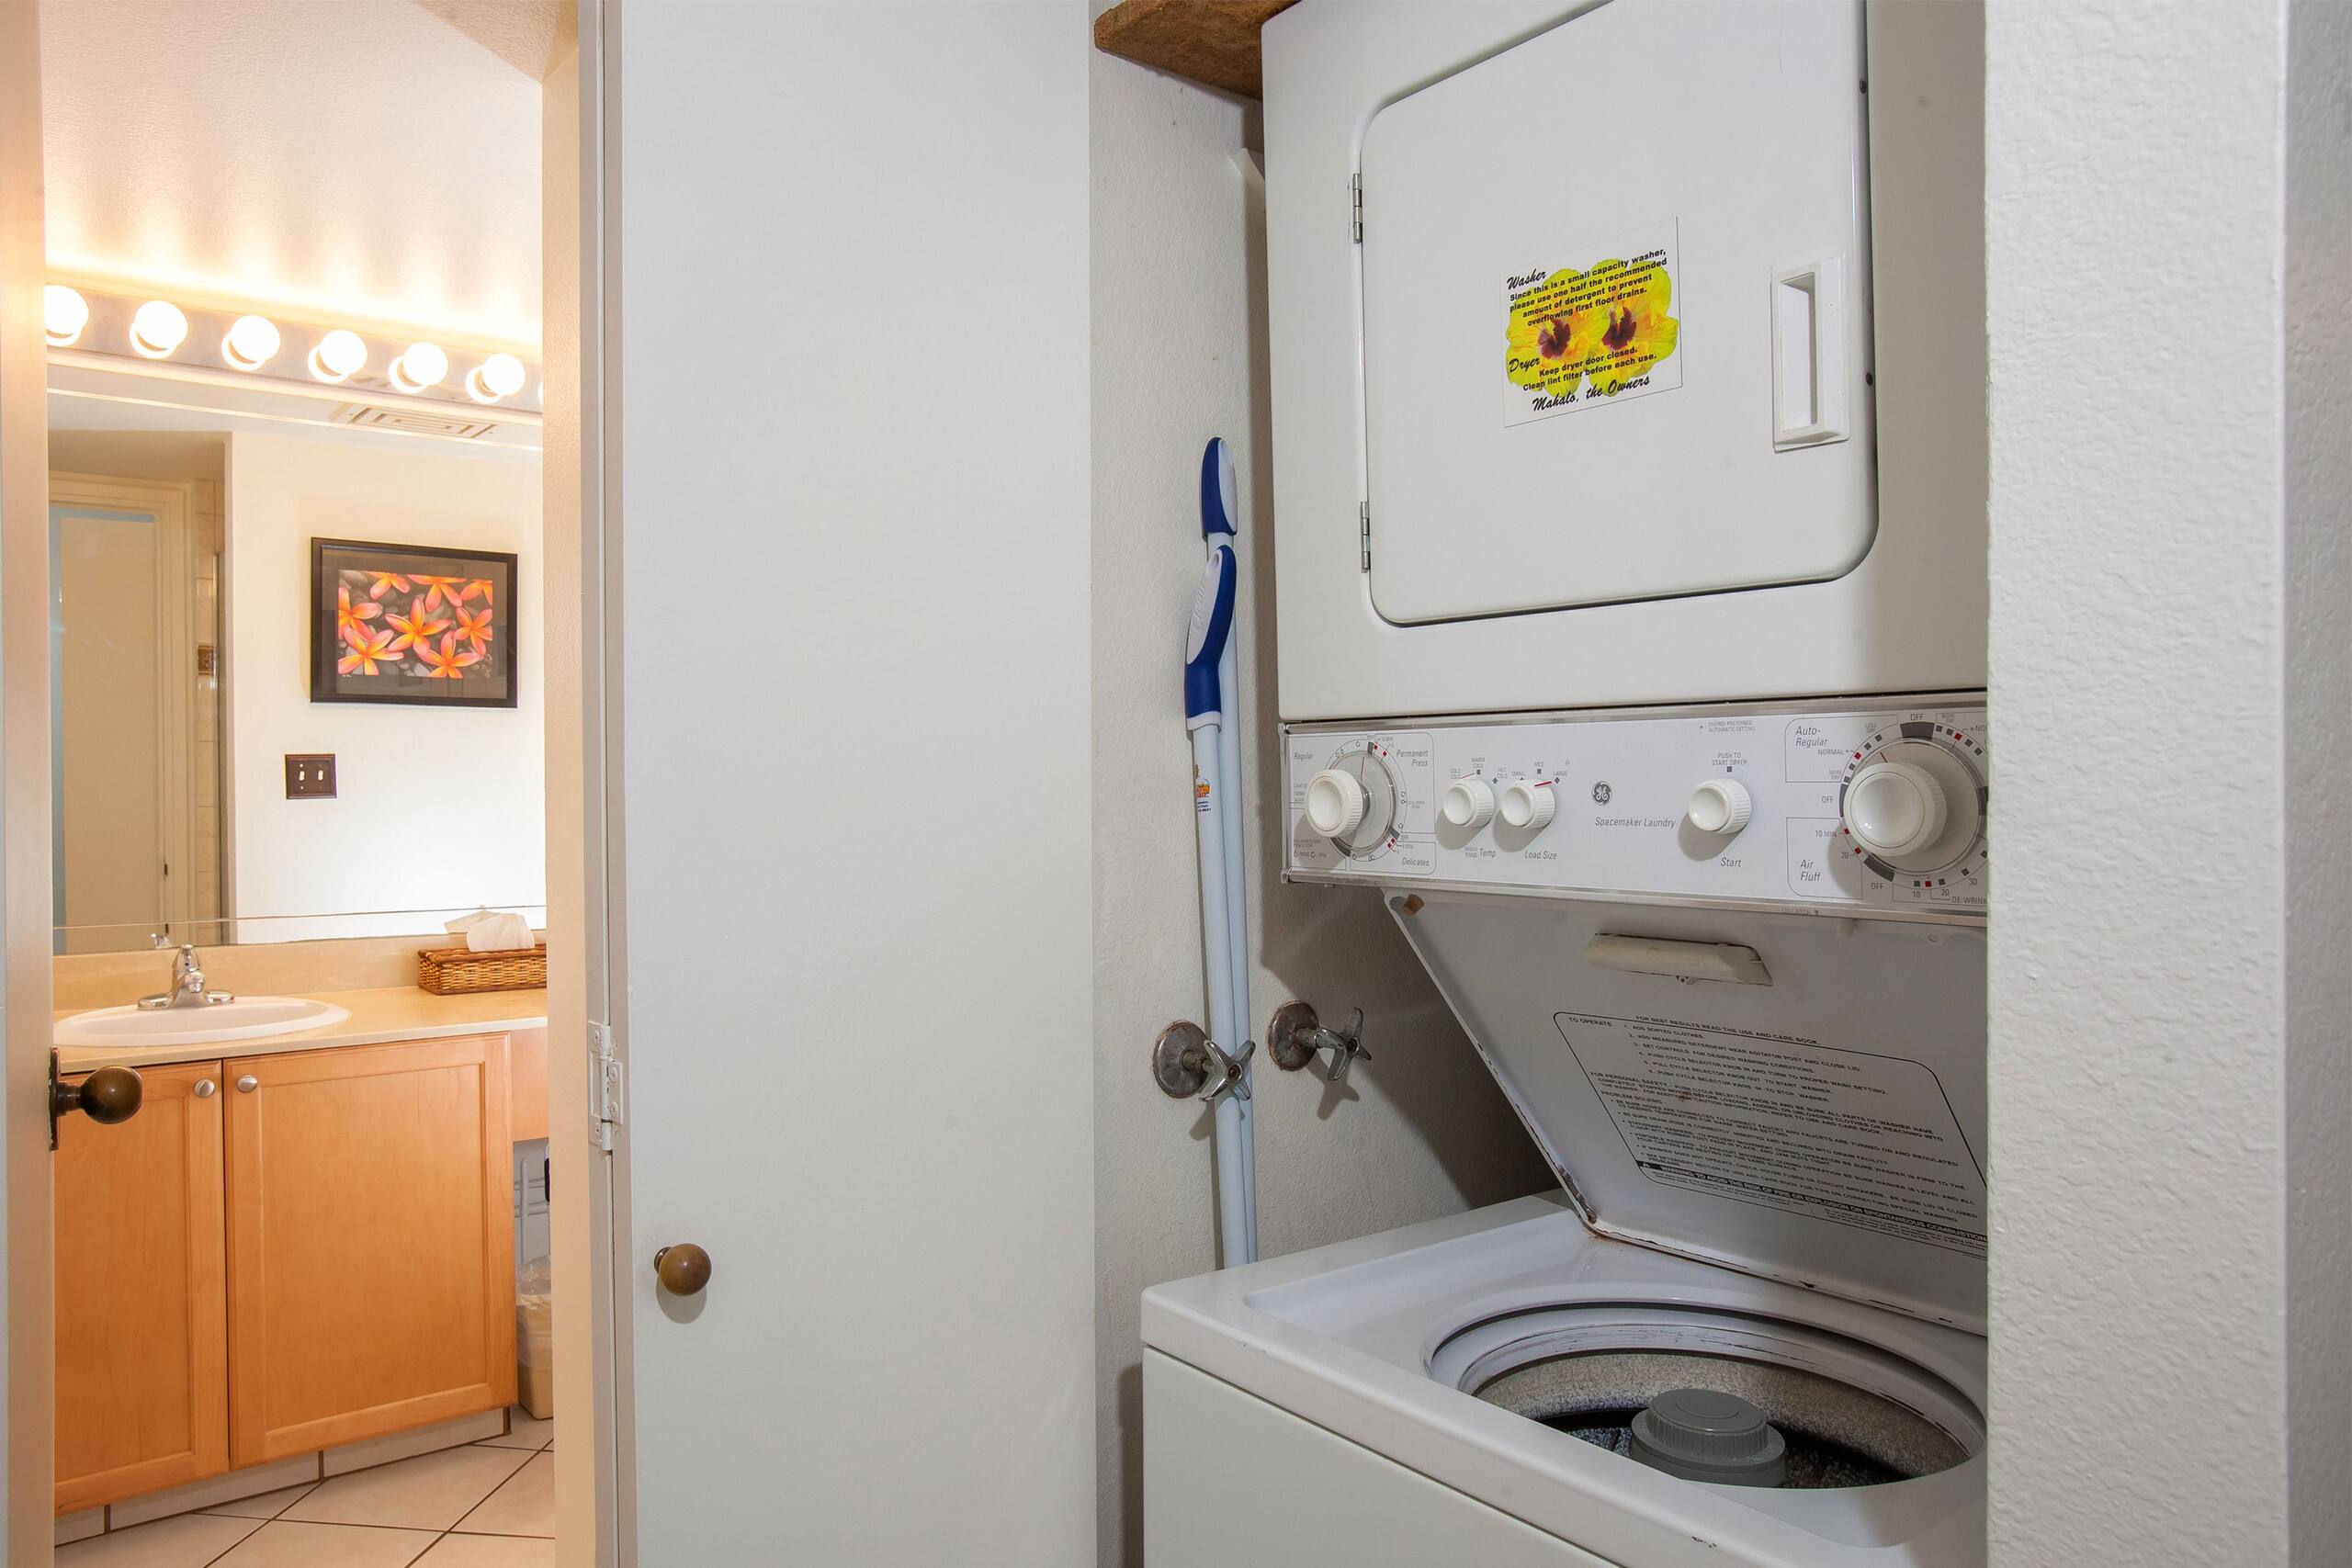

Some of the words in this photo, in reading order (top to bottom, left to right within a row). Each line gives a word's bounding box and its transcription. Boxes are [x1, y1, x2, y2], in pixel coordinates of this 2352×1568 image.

[1507, 268, 1546, 290] Washer
[1510, 289, 1532, 301] Since
[1533, 285, 1548, 294] this
[1567, 270, 1589, 284] small
[1592, 259, 1629, 276] capacity
[1631, 248, 1667, 264] washer,
[1510, 299, 1535, 312] please
[1537, 294, 1551, 303] use
[1554, 289, 1568, 299] one
[1570, 281, 1587, 293] half
[1589, 278, 1602, 288] the
[1605, 257, 1667, 282] recommended
[1522, 304, 1552, 318] amount
[1565, 288, 1605, 305] detergent
[1608, 285, 1616, 293] to
[1619, 274, 1652, 290] prevent
[1528, 308, 1573, 326] overflowing
[1576, 302, 1592, 312] first
[1595, 296, 1615, 307] floor
[1617, 287, 1646, 300] drains.
[1509, 357, 1540, 373] Dryer
[1539, 367, 1559, 378] Keep
[1562, 360, 1583, 371] dryer
[1585, 355, 1604, 366] door
[1607, 346, 1637, 359] closed.
[1522, 381, 1545, 391] Clean
[1547, 377, 1561, 385] lint
[1563, 371, 1583, 381] filter
[1585, 365, 1612, 376] before
[1614, 357, 1635, 368] each
[1638, 354, 1657, 362] use.
[1532, 390, 1579, 412] Mahalo,
[1586, 383, 1602, 400] the
[1608, 376, 1650, 394] Owners
[1911, 713, 1924, 721] OFF
[1794, 726, 1820, 736] Auto-
[1795, 738, 1828, 748] Regular
[1294, 752, 1314, 761] Regular
[1396, 750, 1429, 758] Permanent
[1412, 759, 1428, 767] Press
[1821, 795, 1834, 804] OFF
[1595, 816, 1642, 828] Spacemaker
[1644, 818, 1676, 829] Laundry
[1479, 848, 1497, 858] Temp
[1524, 850, 1541, 859] Load
[1543, 851, 1557, 860] Size
[1402, 856, 1430, 866] Delicates
[1720, 856, 1742, 867] Start
[1800, 859, 1814, 869] Air
[1801, 871, 1821, 882] Fluff
[1968, 877, 1977, 886] 30
[1870, 882, 1884, 890] OFF
[1912, 890, 1921, 898] 10
[1579, 1018, 1613, 1028] OPERATE
